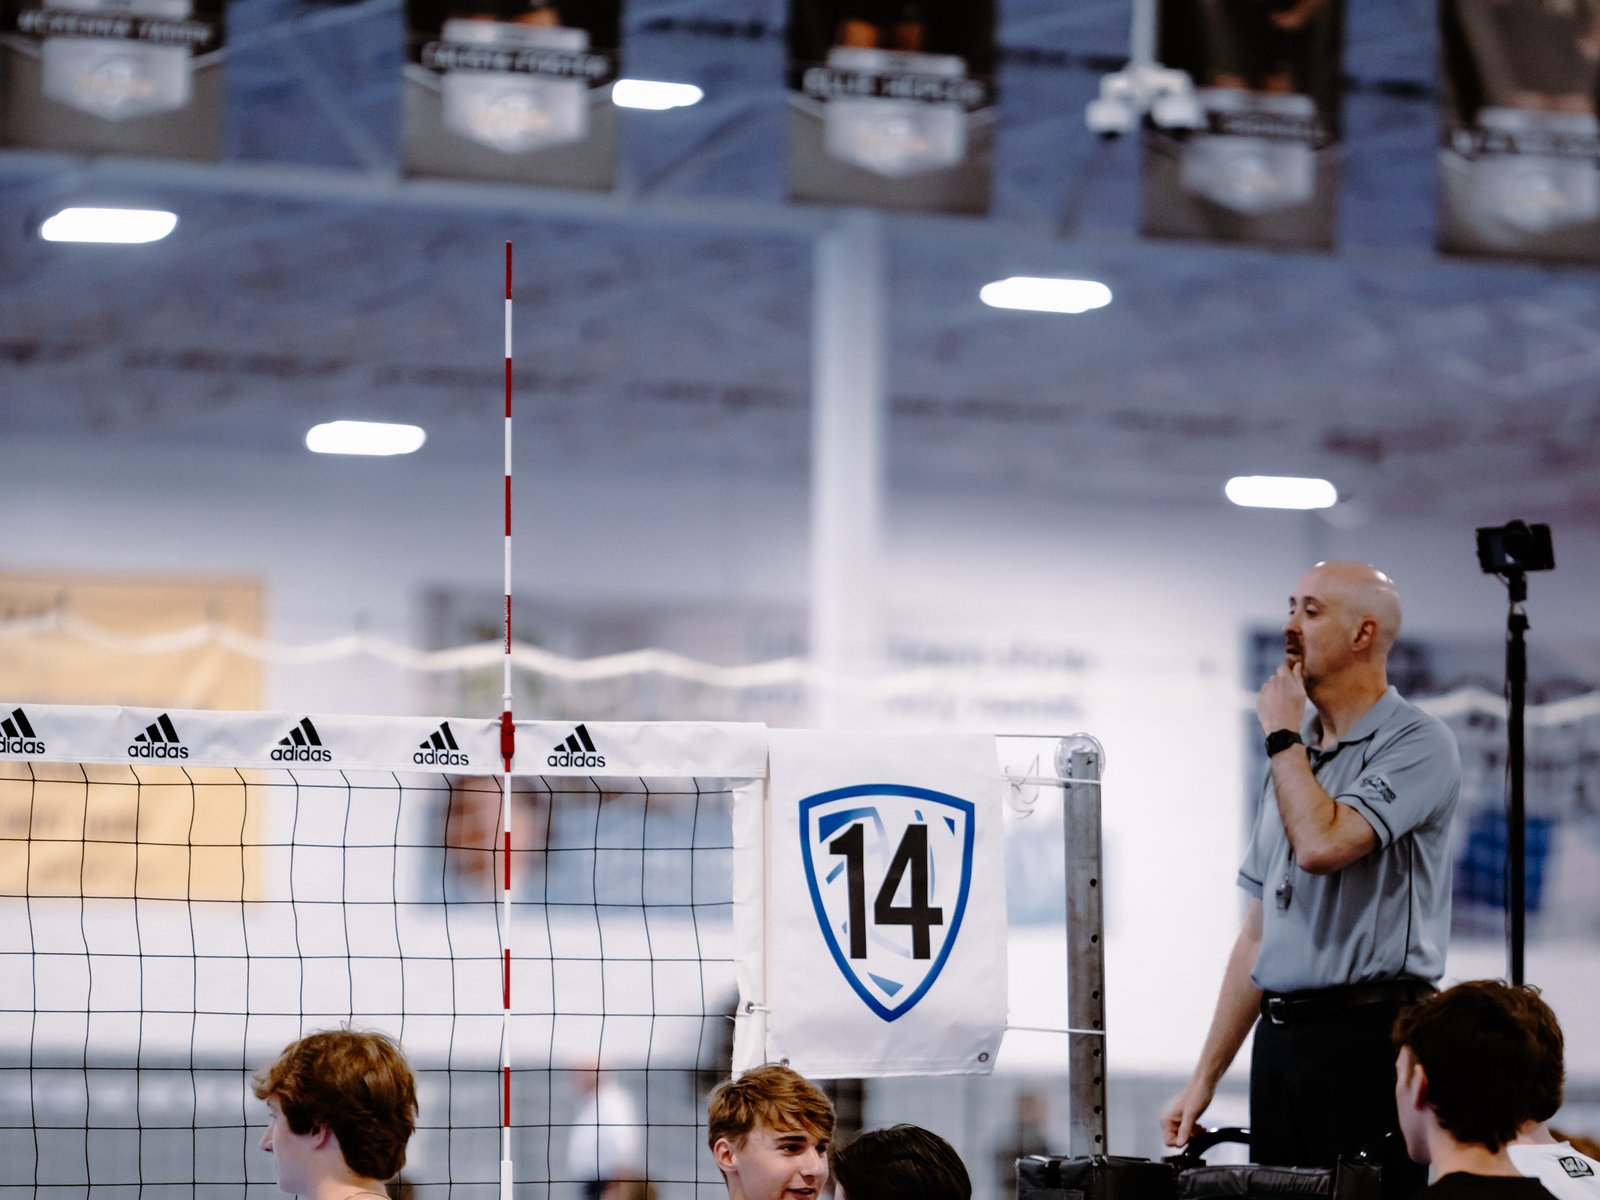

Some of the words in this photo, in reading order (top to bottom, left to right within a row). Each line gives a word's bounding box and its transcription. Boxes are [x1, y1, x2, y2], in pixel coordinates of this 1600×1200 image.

[0, 737, 45, 754] didas
[128, 741, 189, 758] adidas
[270, 745, 332, 762] adidas
[413, 749, 469, 766] adidas
[547, 752, 606, 768] adidas
[829, 823, 943, 960] 14
